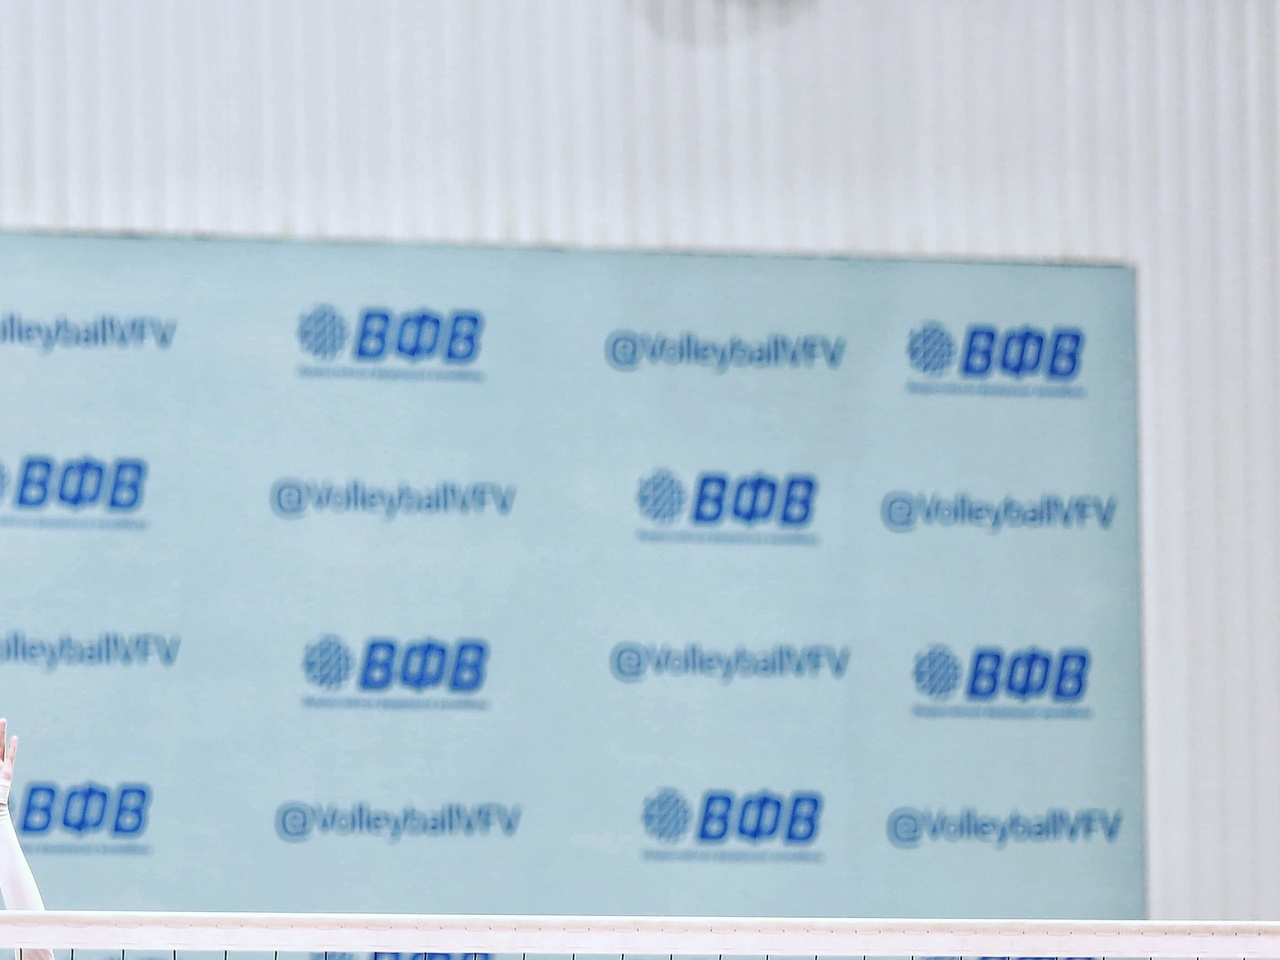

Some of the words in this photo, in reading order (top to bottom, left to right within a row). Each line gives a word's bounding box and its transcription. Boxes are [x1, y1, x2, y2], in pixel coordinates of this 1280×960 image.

[353, 308, 485, 365] ВФВ
[605, 328, 847, 373] @VolleyballVFV
[960, 322, 1085, 380] ВФВ
[14, 454, 149, 511] ВФВ
[270, 477, 517, 520] @VolleyballVFV
[691, 471, 819, 527] ВФВ
[881, 490, 1119, 533] @VolleyballVFV
[359, 637, 489, 694] ВФВ
[610, 641, 851, 684] @VolleyballVFV
[965, 646, 1091, 702] ВФВ
[20, 781, 152, 838] ВФВ
[275, 801, 522, 843] @VolleyballVFV
[696, 789, 823, 845] ВФВ
[887, 806, 1124, 849] @VolleyballVFV
